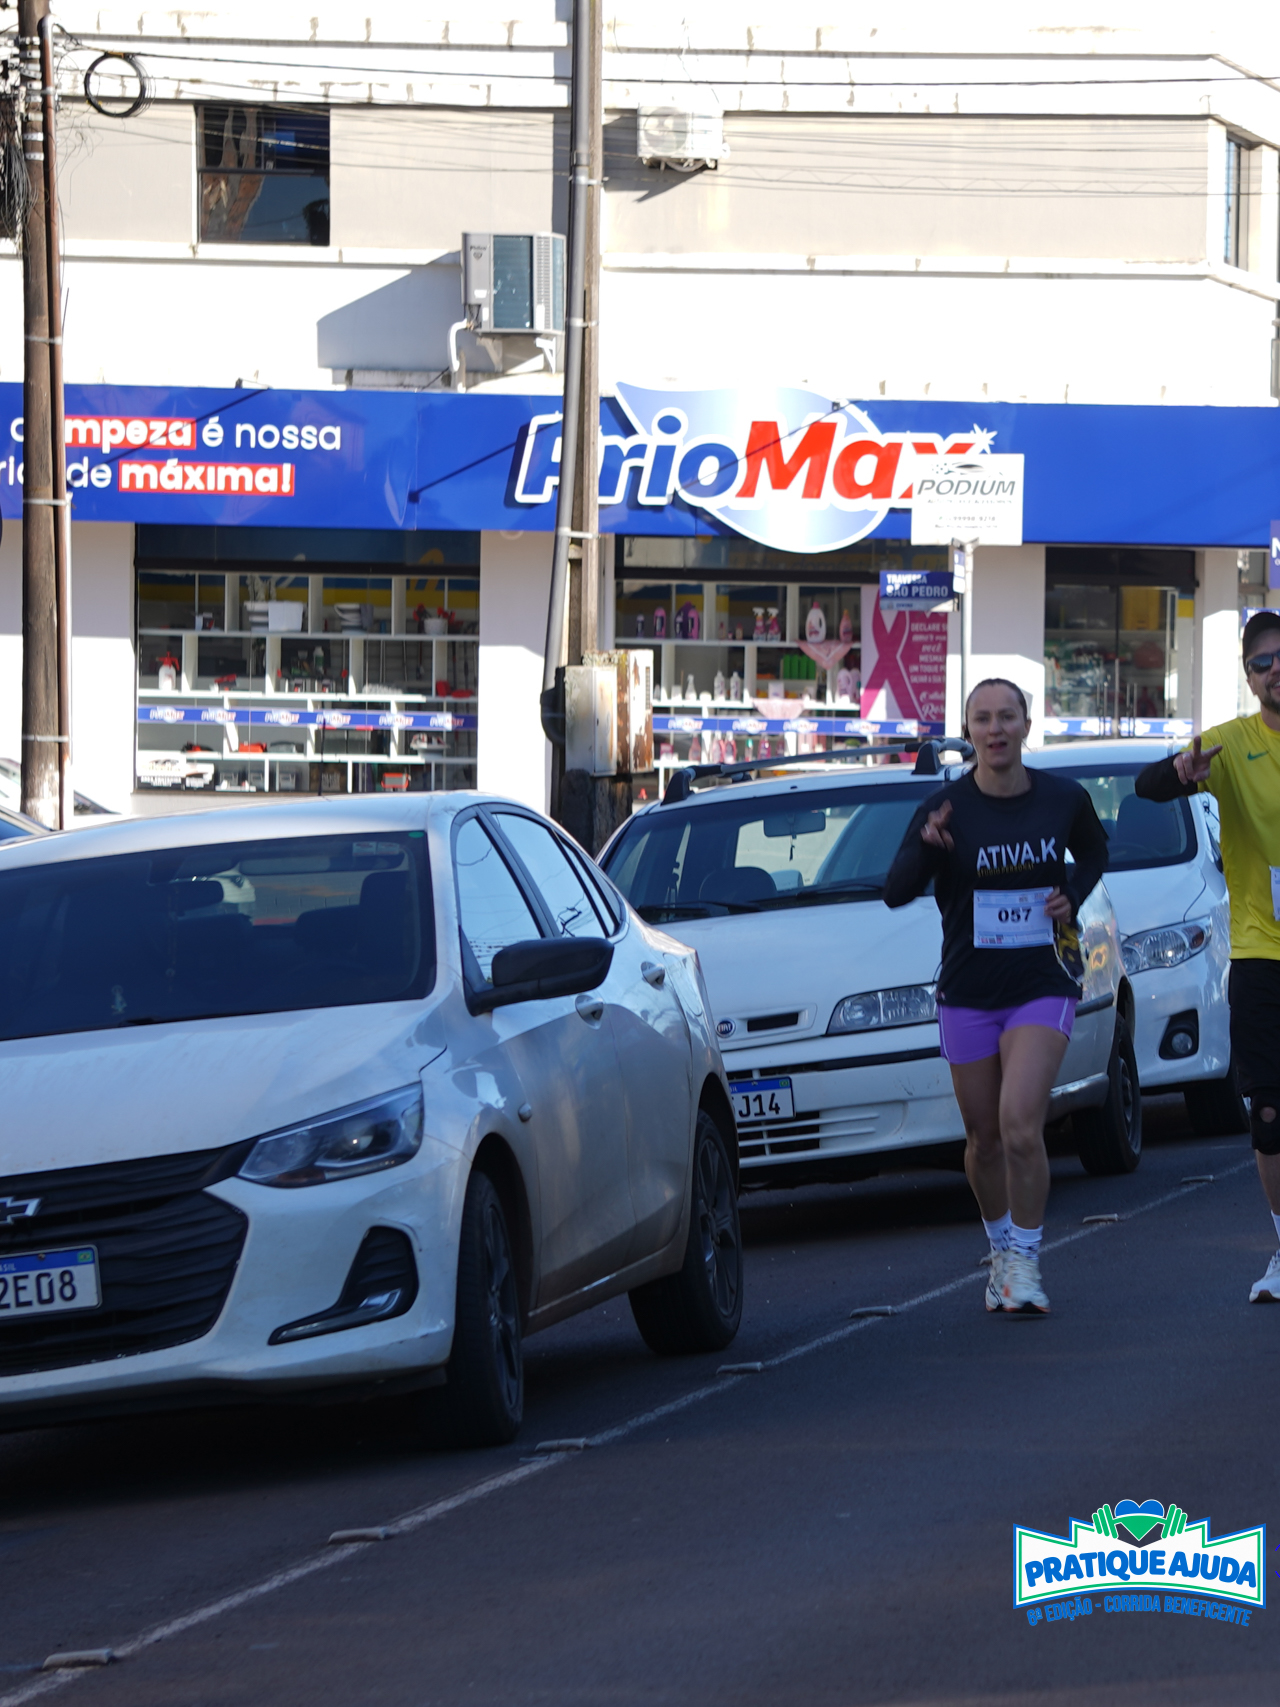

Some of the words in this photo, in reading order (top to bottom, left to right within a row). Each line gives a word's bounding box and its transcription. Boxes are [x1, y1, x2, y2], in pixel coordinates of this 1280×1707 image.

[202, 416, 224, 447] é
[235, 422, 341, 451] nossa
[121, 458, 292, 493] máxima!
[917, 479, 1016, 496] PODIUM
[911, 586, 949, 597] PEDRO
[976, 836, 1058, 871] ATIVA.K
[998, 907, 1032, 923] 057
